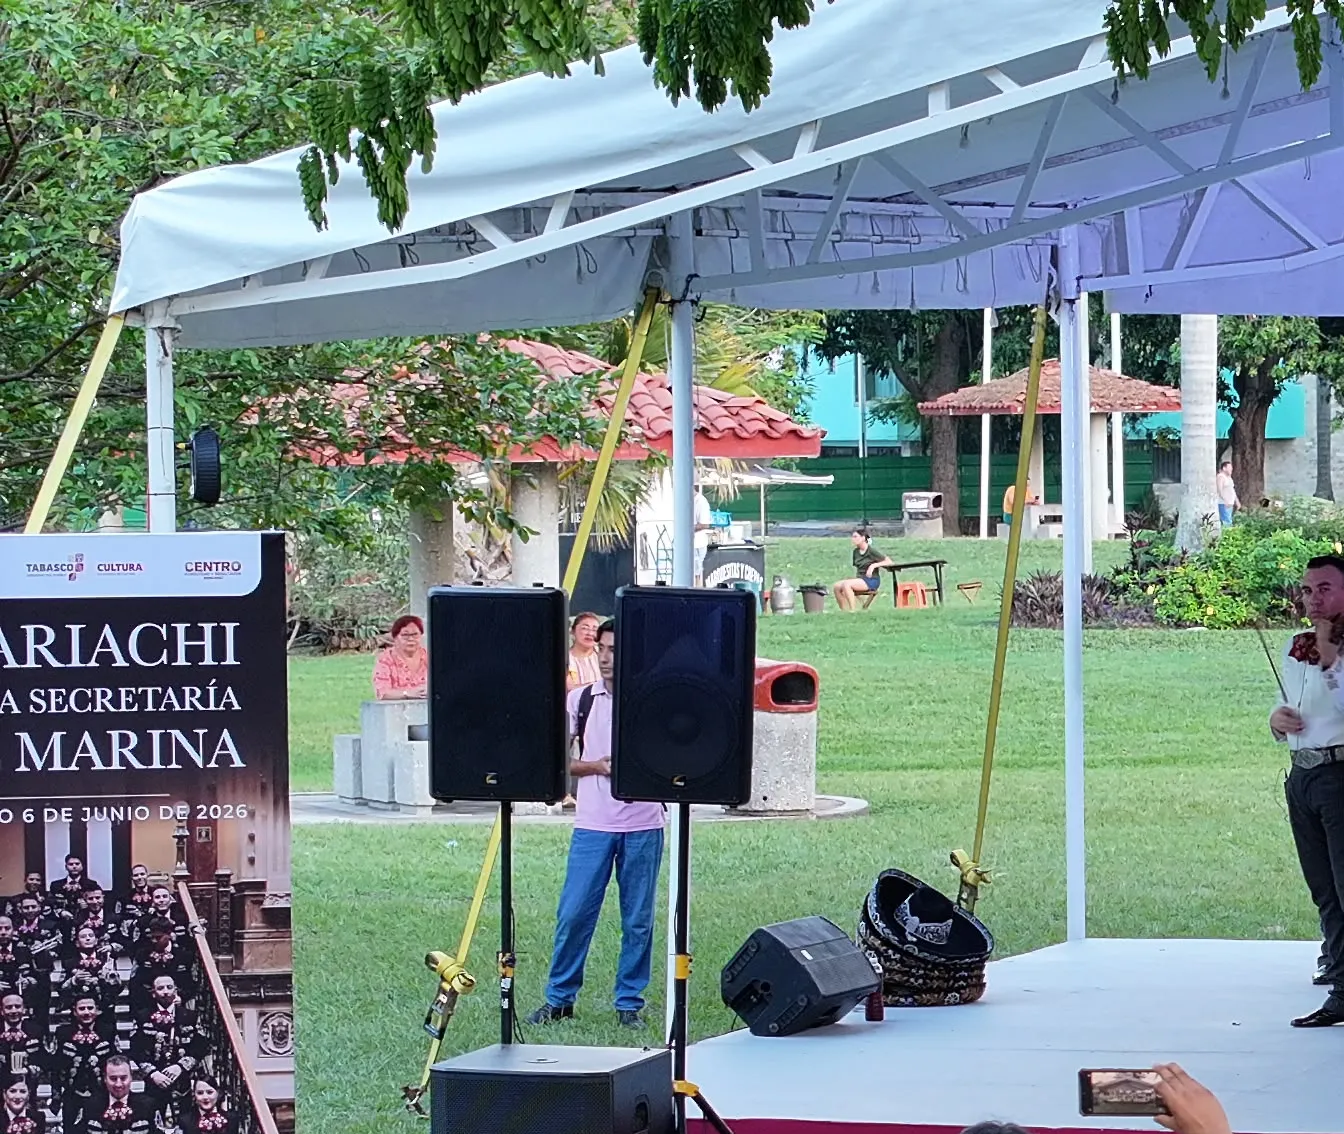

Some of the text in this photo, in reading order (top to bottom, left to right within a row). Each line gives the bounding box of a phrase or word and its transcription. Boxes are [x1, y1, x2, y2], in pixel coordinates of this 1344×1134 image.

[26, 563, 74, 573] TABASCO
[98, 563, 143, 572] CULTURA
[184, 561, 242, 573] CENTRO
[0, 623, 240, 668] ARIACHI
[29, 678, 241, 714] SECRETARÍA
[15, 728, 246, 772] MARINA
[23, 809, 34, 824] 6
[44, 807, 73, 823] DE
[81, 805, 150, 822] JUNIO
[159, 805, 188, 820] DE
[196, 804, 248, 820] 2026
